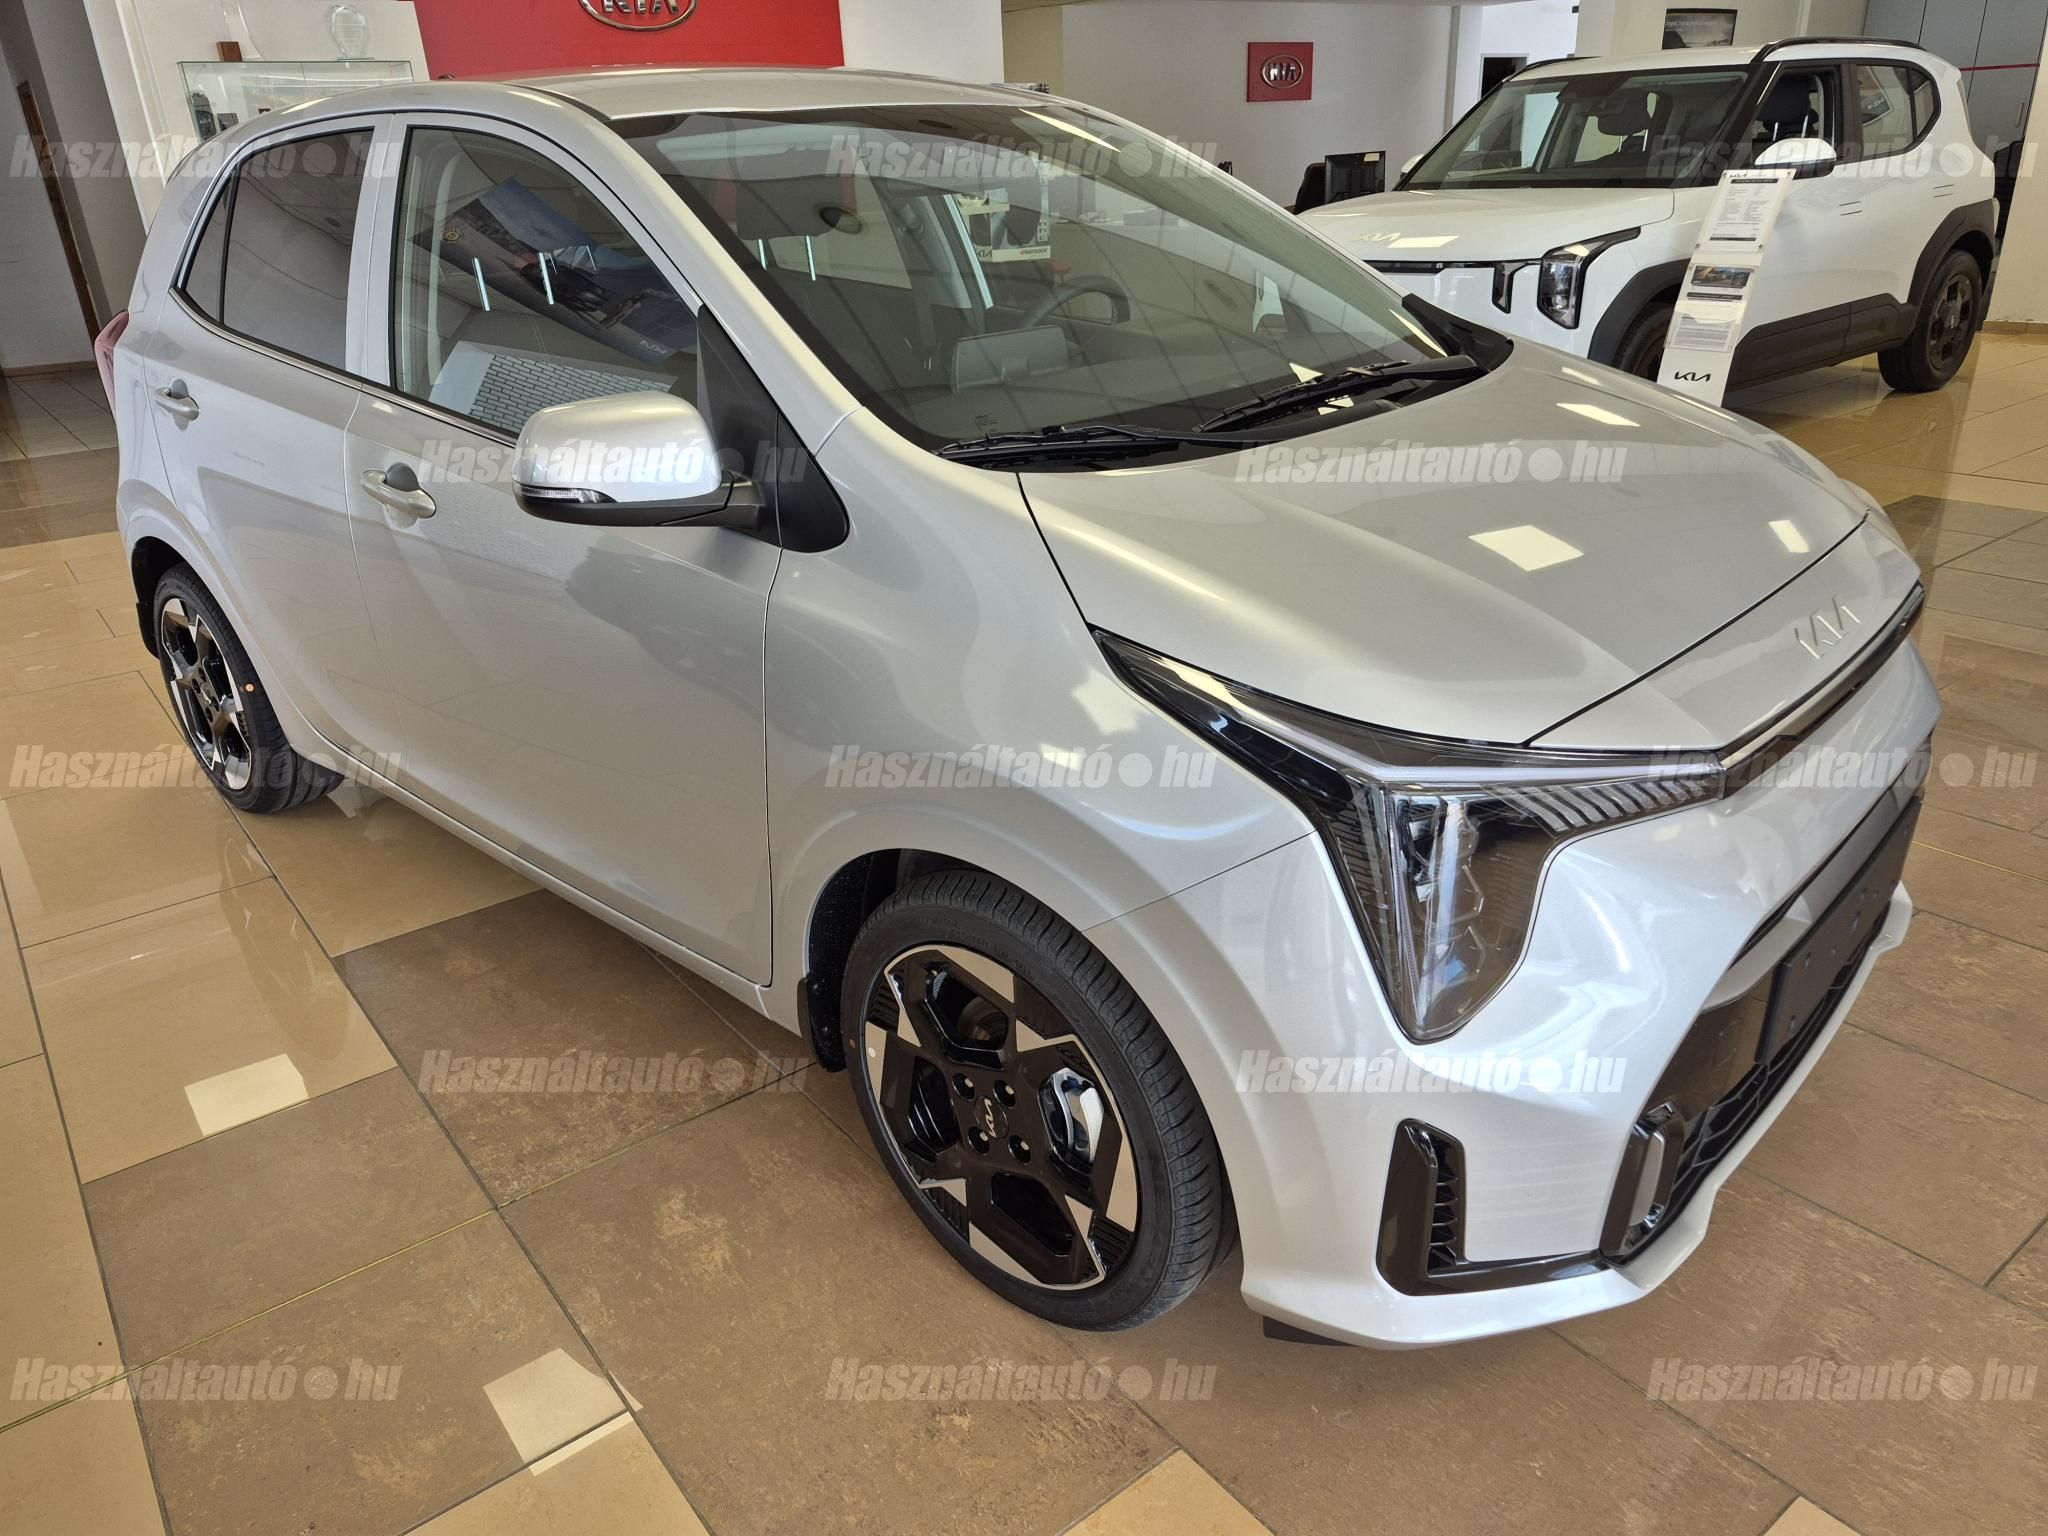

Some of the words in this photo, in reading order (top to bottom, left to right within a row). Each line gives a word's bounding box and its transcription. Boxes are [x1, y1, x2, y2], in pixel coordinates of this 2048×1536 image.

[1269, 63, 1297, 80] KIA
[1674, 371, 1711, 382] KIA
[1793, 594, 1862, 660] KIA
